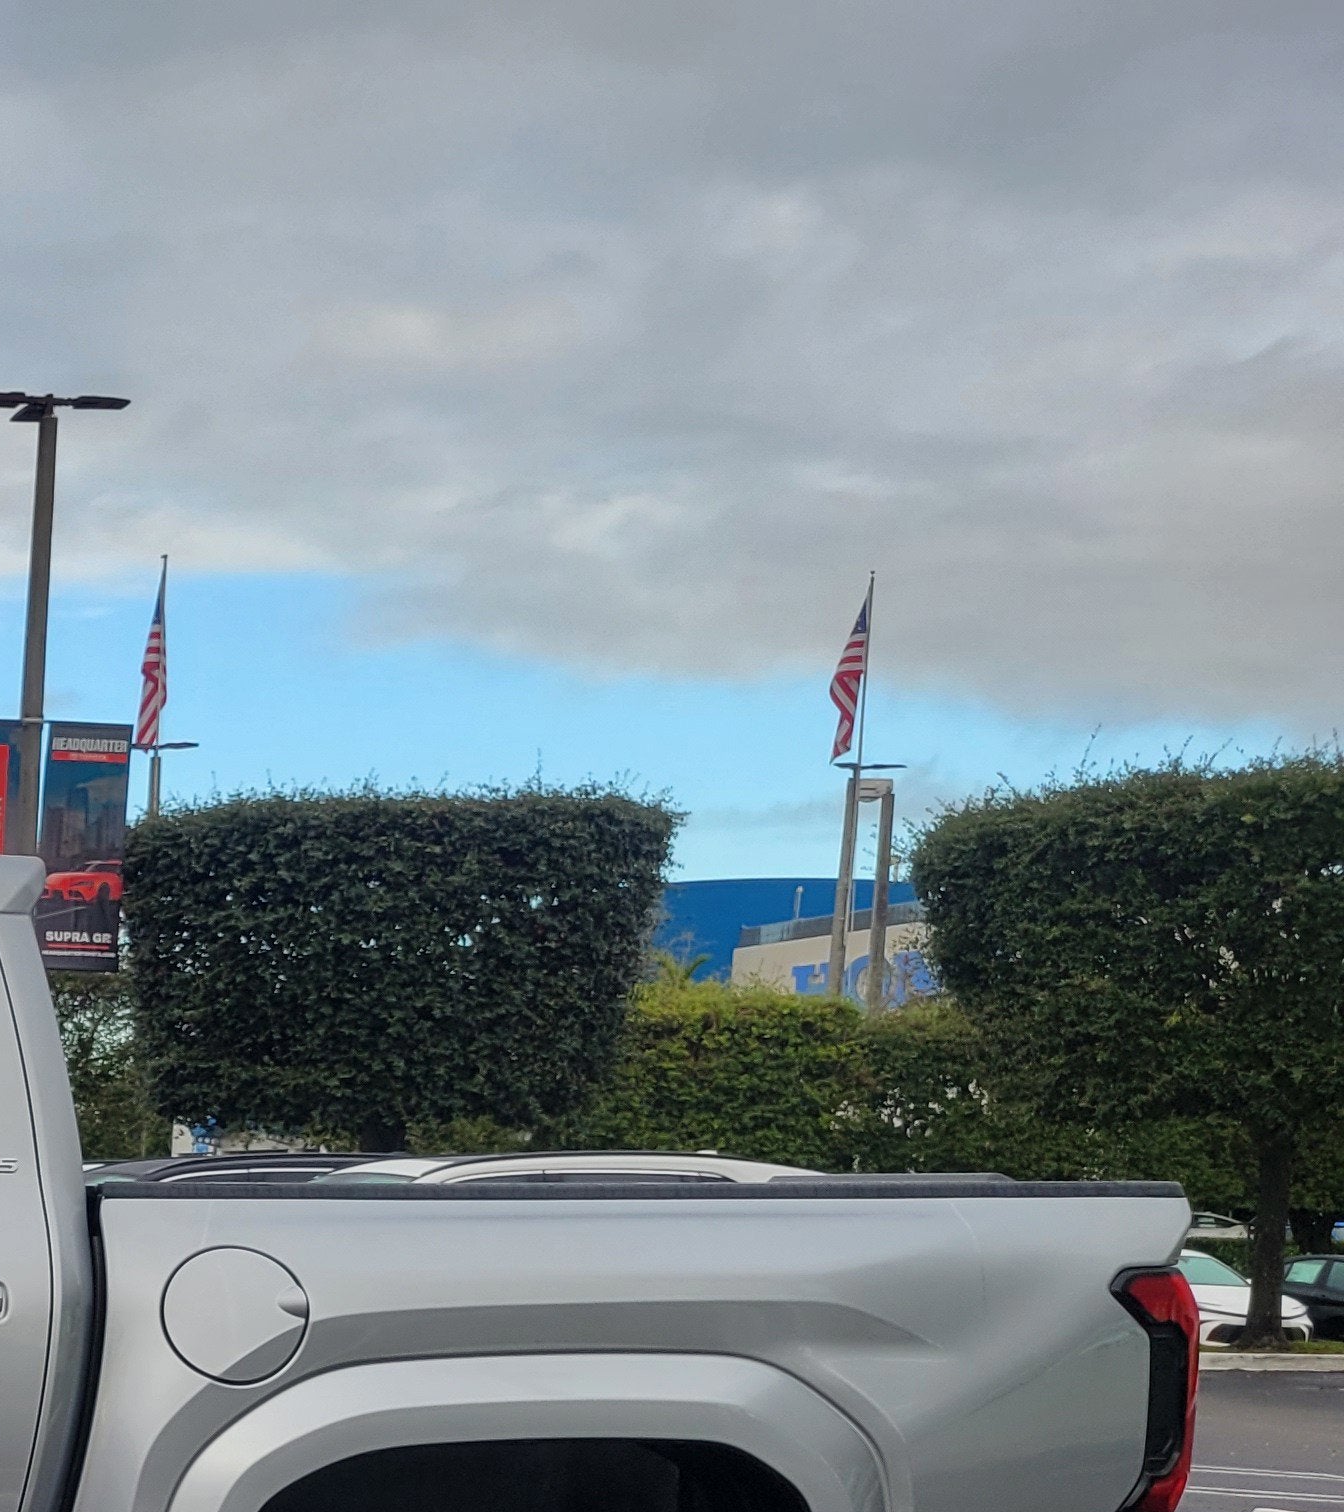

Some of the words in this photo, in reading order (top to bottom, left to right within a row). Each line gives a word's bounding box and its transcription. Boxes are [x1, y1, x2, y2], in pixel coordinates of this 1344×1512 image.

[52, 737, 129, 753] HEADQUARTER
[45, 930, 90, 943] SUPRA
[92, 932, 112, 944] GR
